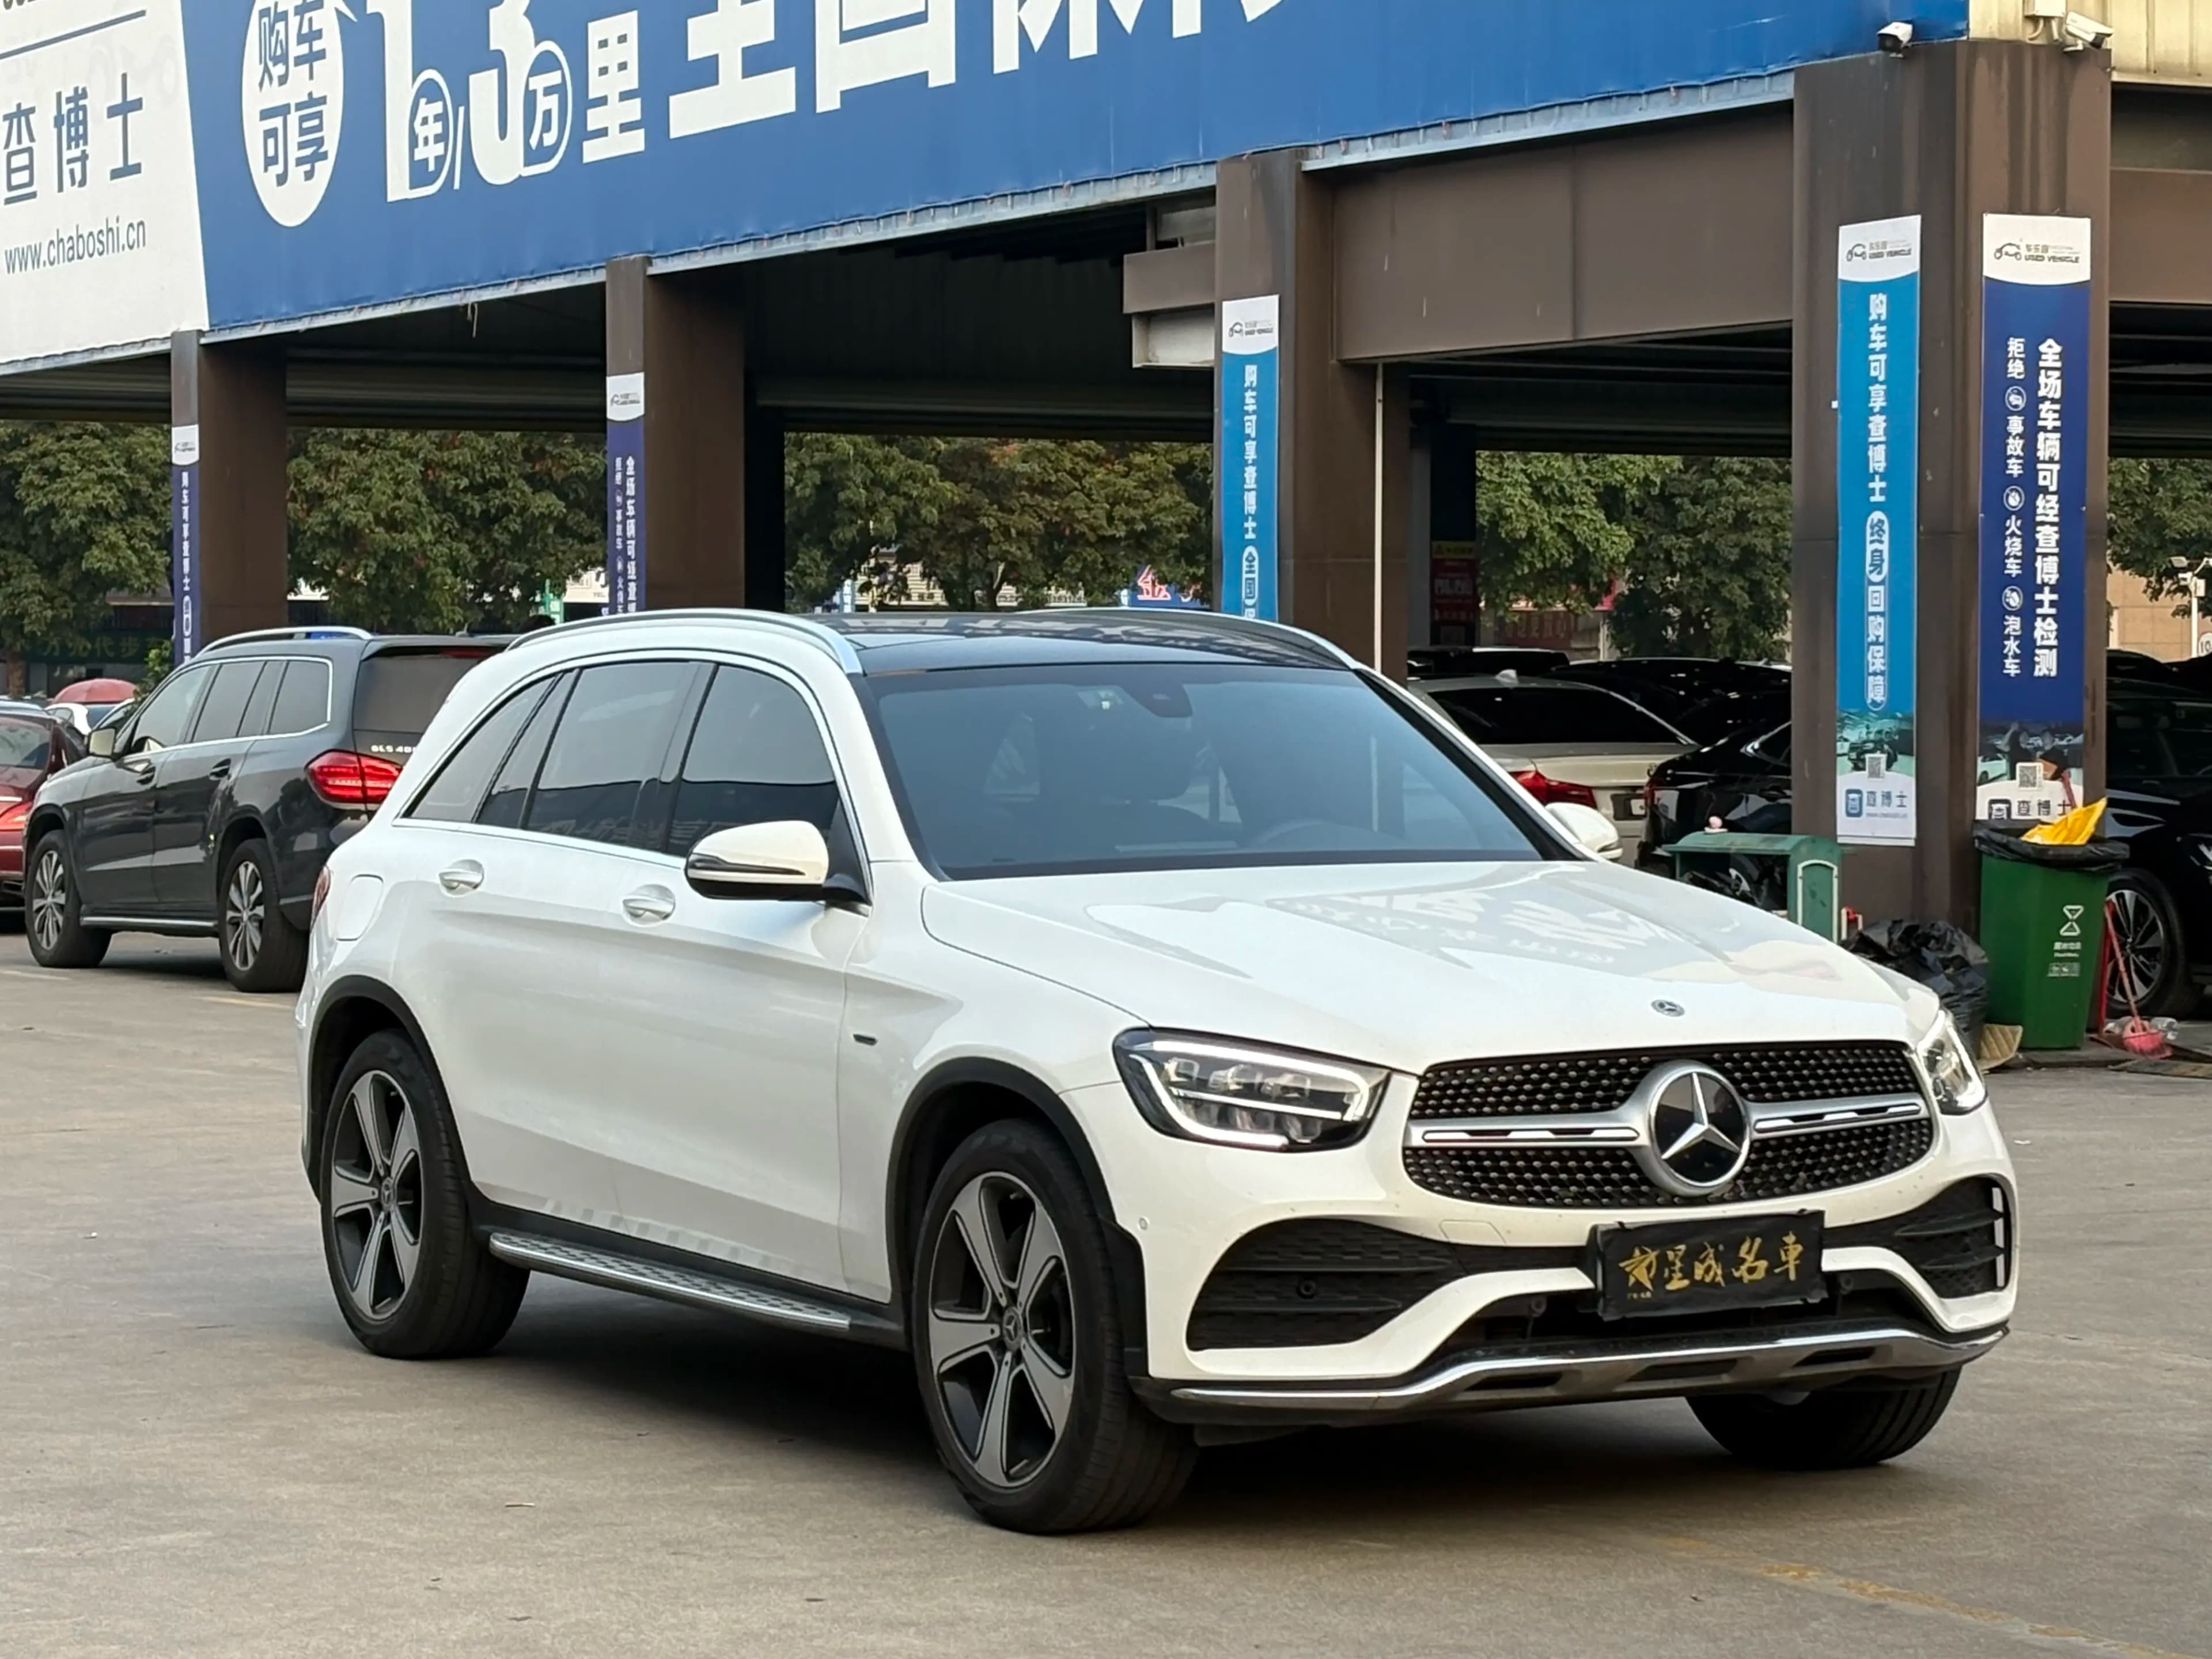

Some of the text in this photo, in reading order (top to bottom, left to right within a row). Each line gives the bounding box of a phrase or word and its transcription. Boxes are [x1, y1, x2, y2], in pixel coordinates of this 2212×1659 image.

[2, 72, 143, 206] 查博士
[259, 91, 329, 187] 可享
[5, 215, 146, 275] www.chaboshi.cn
[1868, 293, 1887, 502] 购车可享查博士
[2007, 338, 2025, 380] 拒绝
[2033, 338, 2063, 677] 全场车辆可经查博士检测
[2017, 799, 2072, 817] 查博士
